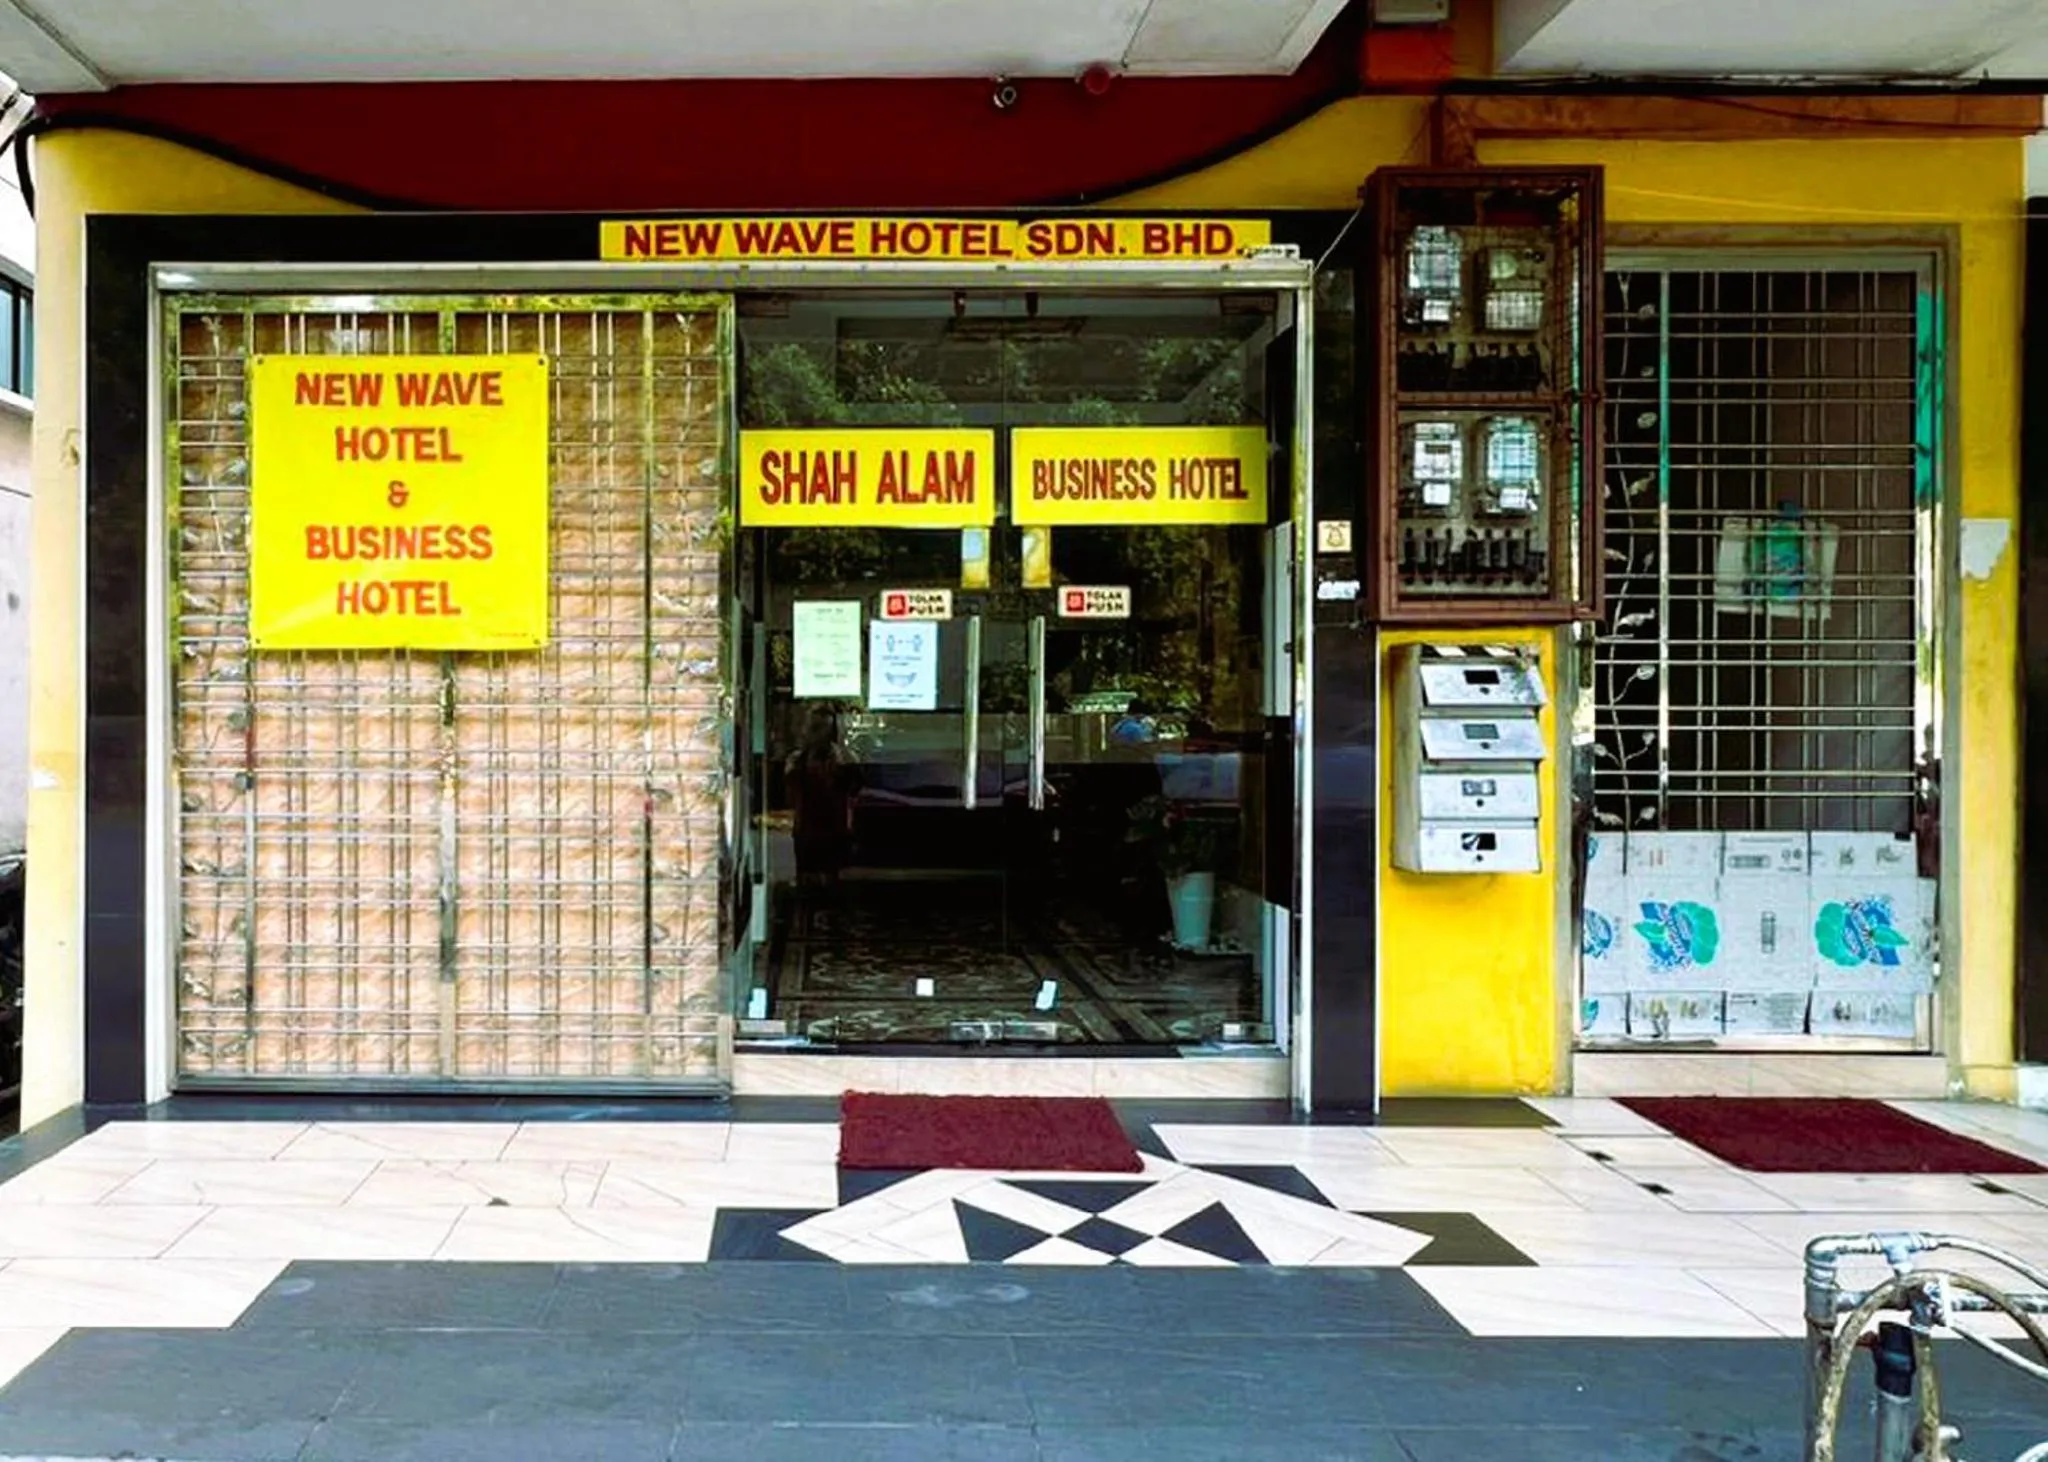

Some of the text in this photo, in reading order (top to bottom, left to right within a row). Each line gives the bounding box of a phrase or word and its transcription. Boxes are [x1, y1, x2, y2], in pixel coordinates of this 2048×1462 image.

[624, 221, 1243, 256] NEW WAVE HOTEL SDN. BHD.
[295, 371, 504, 406] NEW WAVE
[335, 425, 463, 462] HOTEL
[759, 449, 975, 504] SHAH ALAM
[1032, 457, 1249, 500] BUSINESS HOTEL
[387, 480, 409, 509] &
[306, 524, 493, 560] BUSINESS
[336, 580, 462, 616] HOTEL
[908, 605, 945, 615] PUSH
[1086, 602, 1124, 612] PUSH
